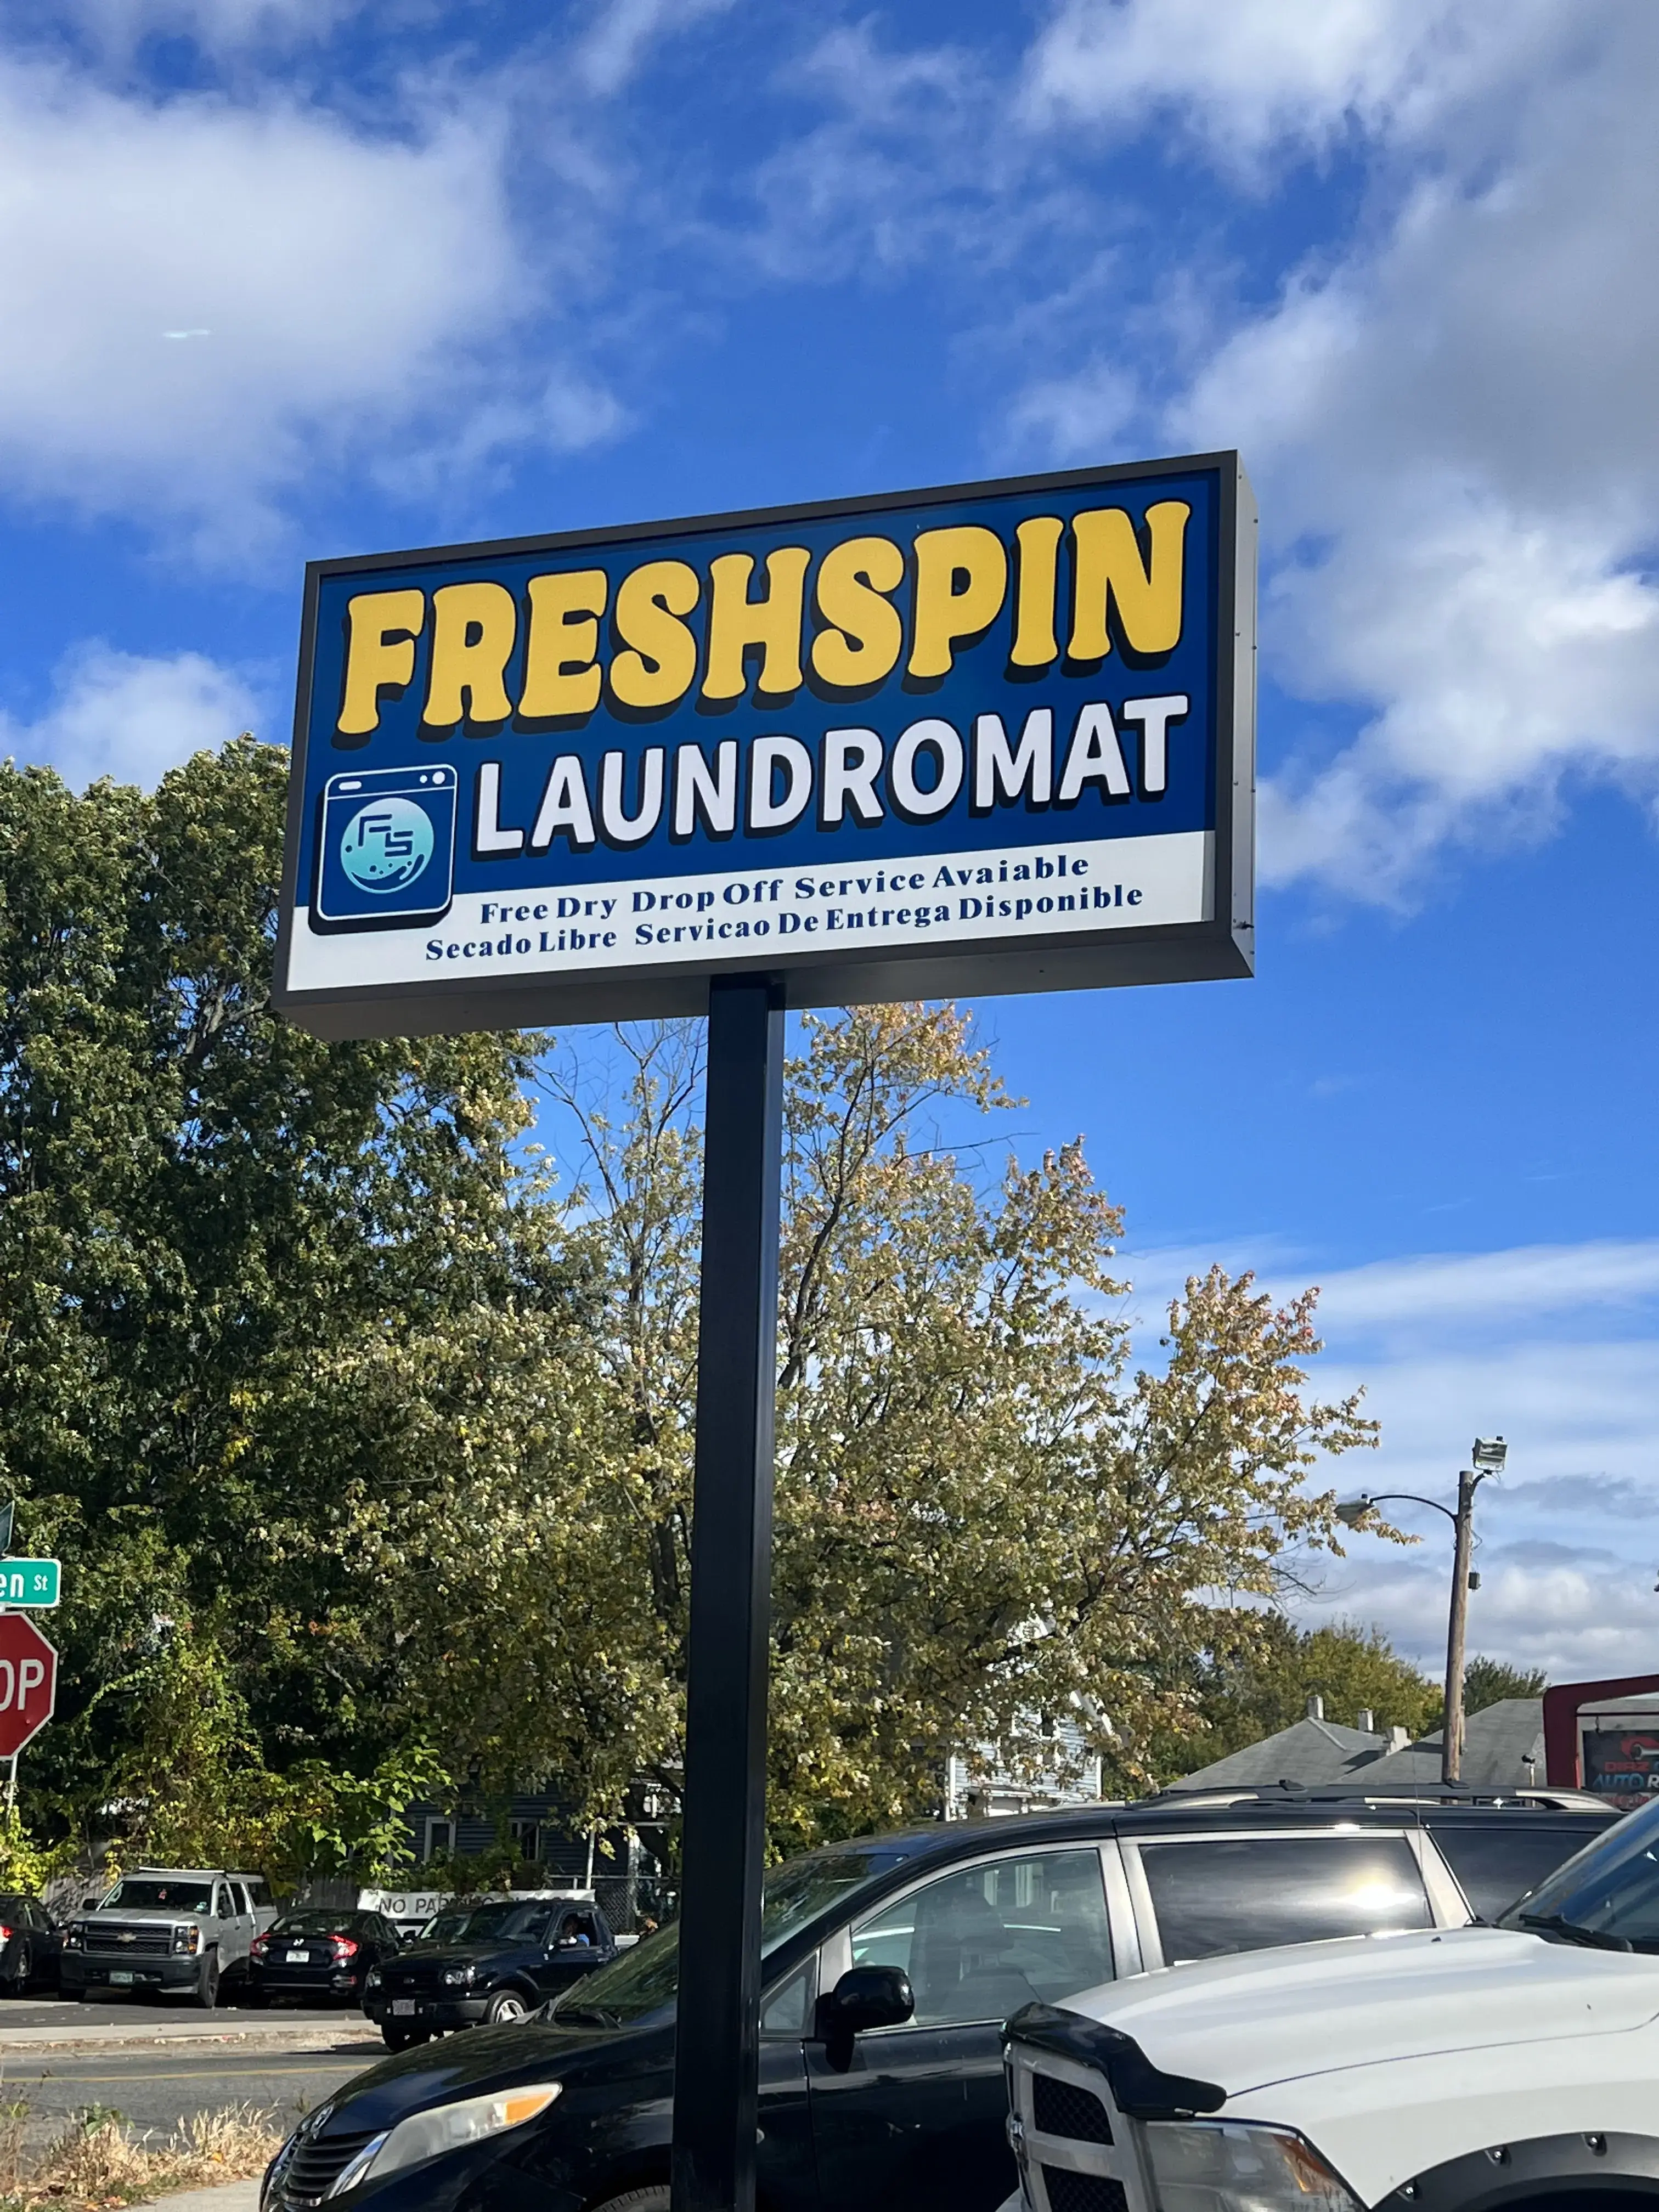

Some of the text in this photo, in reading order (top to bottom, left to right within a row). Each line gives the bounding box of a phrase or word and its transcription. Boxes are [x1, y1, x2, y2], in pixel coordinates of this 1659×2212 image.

[337, 501, 1190, 734] FRESHSPIN
[476, 695, 1188, 852] LAUNDROMAT
[426, 885, 1142, 960] Secado Libre Servicao De Entrega Disponible
[481, 855, 1088, 924] Free Dry Drop Off Service Avaiable
[33, 1573, 48, 1592] St
[1592, 1773, 1644, 1788] AUTO
[379, 1898, 406, 1913] NO
